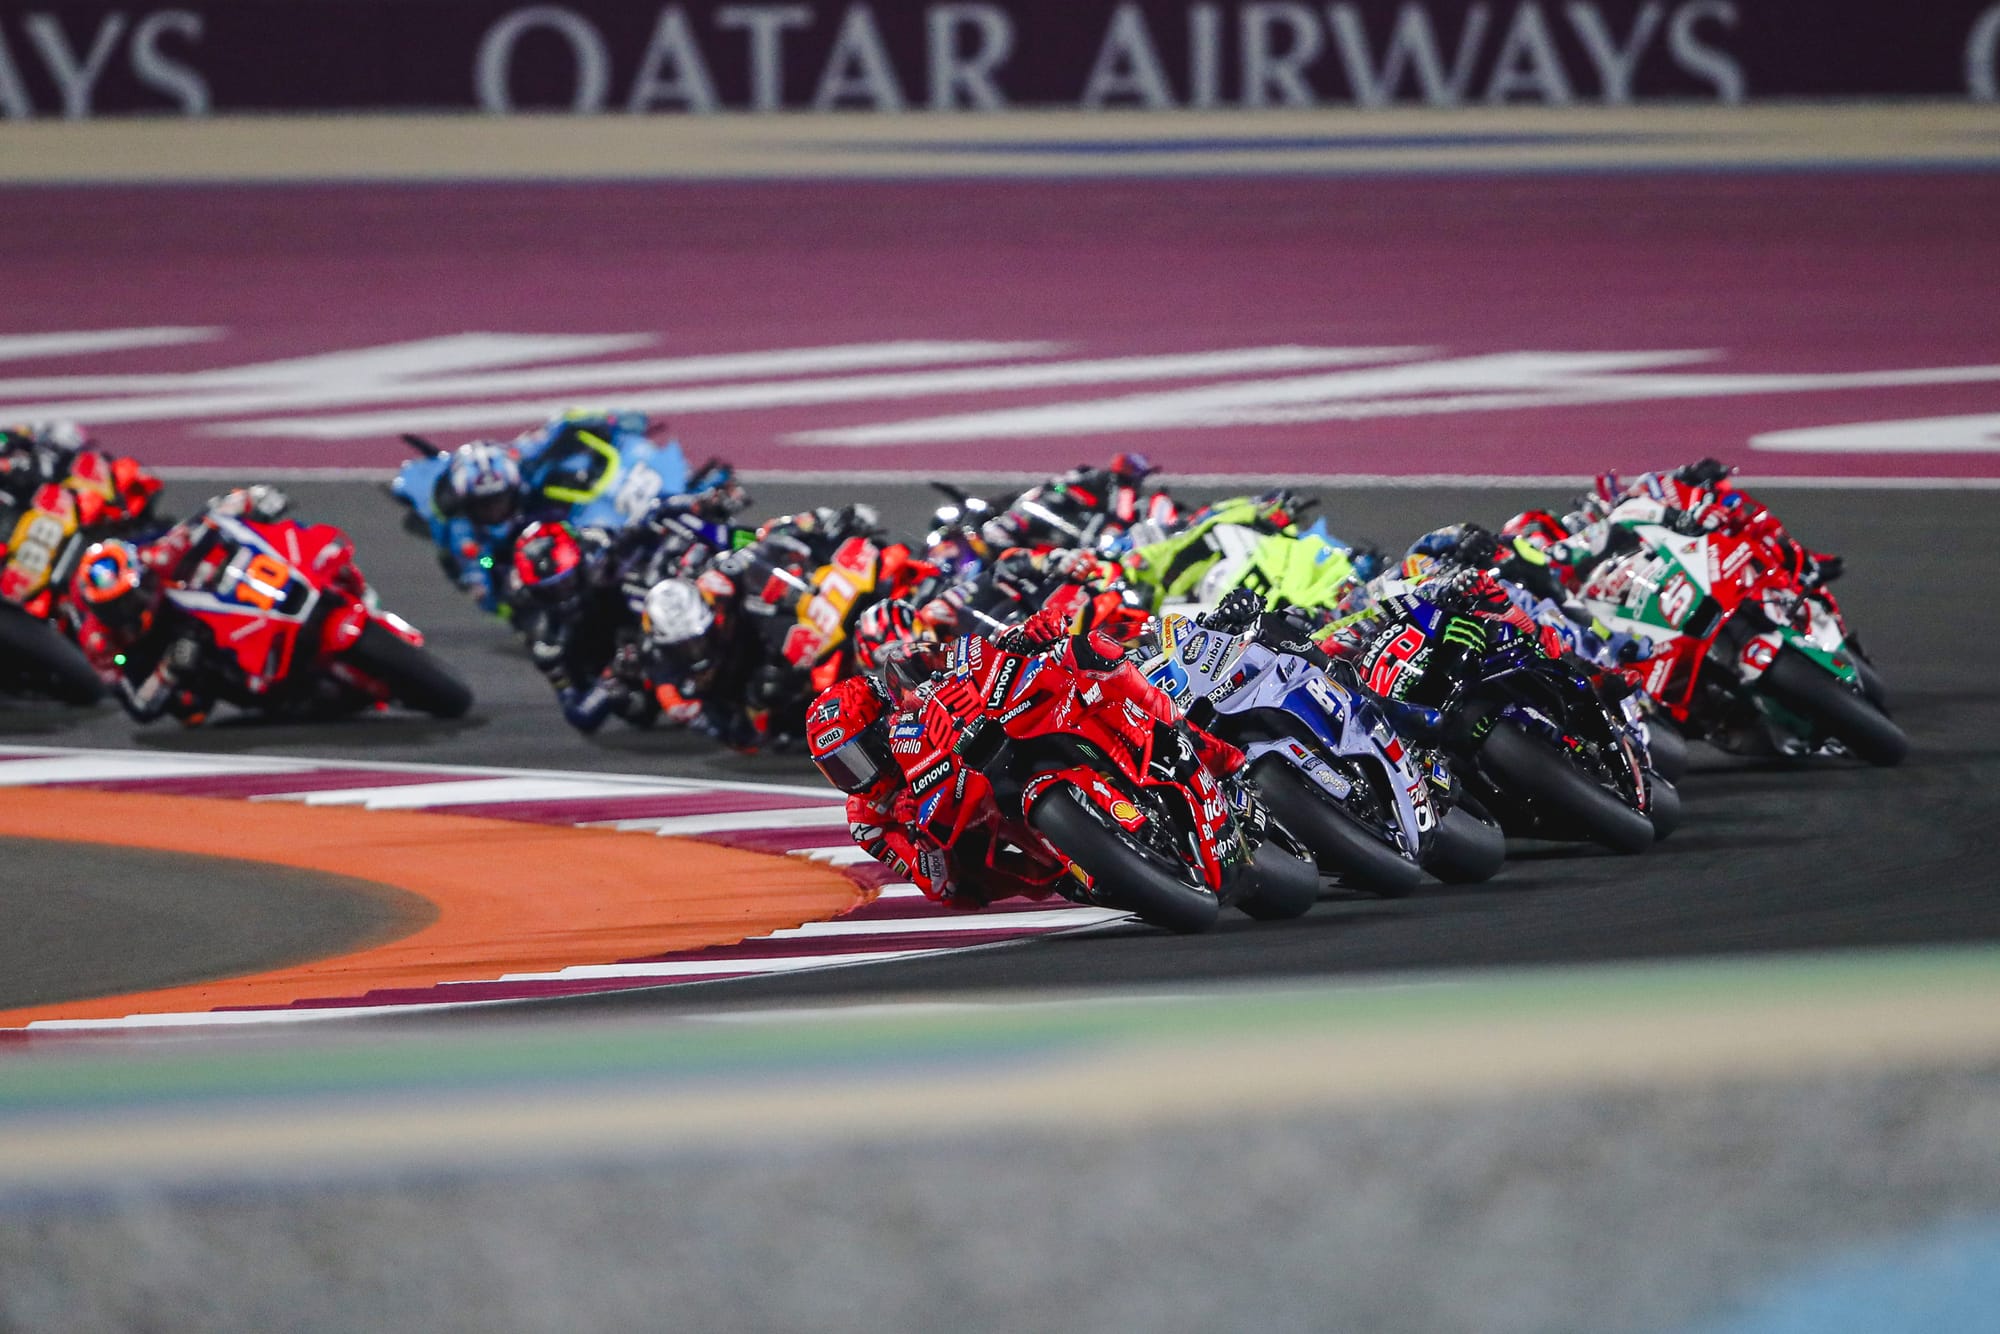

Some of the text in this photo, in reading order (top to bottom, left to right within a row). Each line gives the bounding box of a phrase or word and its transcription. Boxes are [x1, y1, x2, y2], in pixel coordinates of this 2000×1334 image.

[0, 12, 210, 118] YS
[474, 0, 1746, 114] QATAR AIRWAYS
[235, 553, 290, 611] 10
[807, 571, 857, 635] 37
[1659, 571, 1696, 630] 5
[1200, 637, 1224, 673] Unibat
[1363, 623, 1403, 667] ENEOS
[1367, 623, 1425, 698] 20
[988, 658, 1016, 707] Lenovo
[1208, 677, 1233, 700] BOLD
[1000, 700, 1031, 724] CARRERA
[818, 728, 841, 748] SHOEI
[912, 761, 950, 794] Lenovo
[928, 792, 941, 816] TIM
